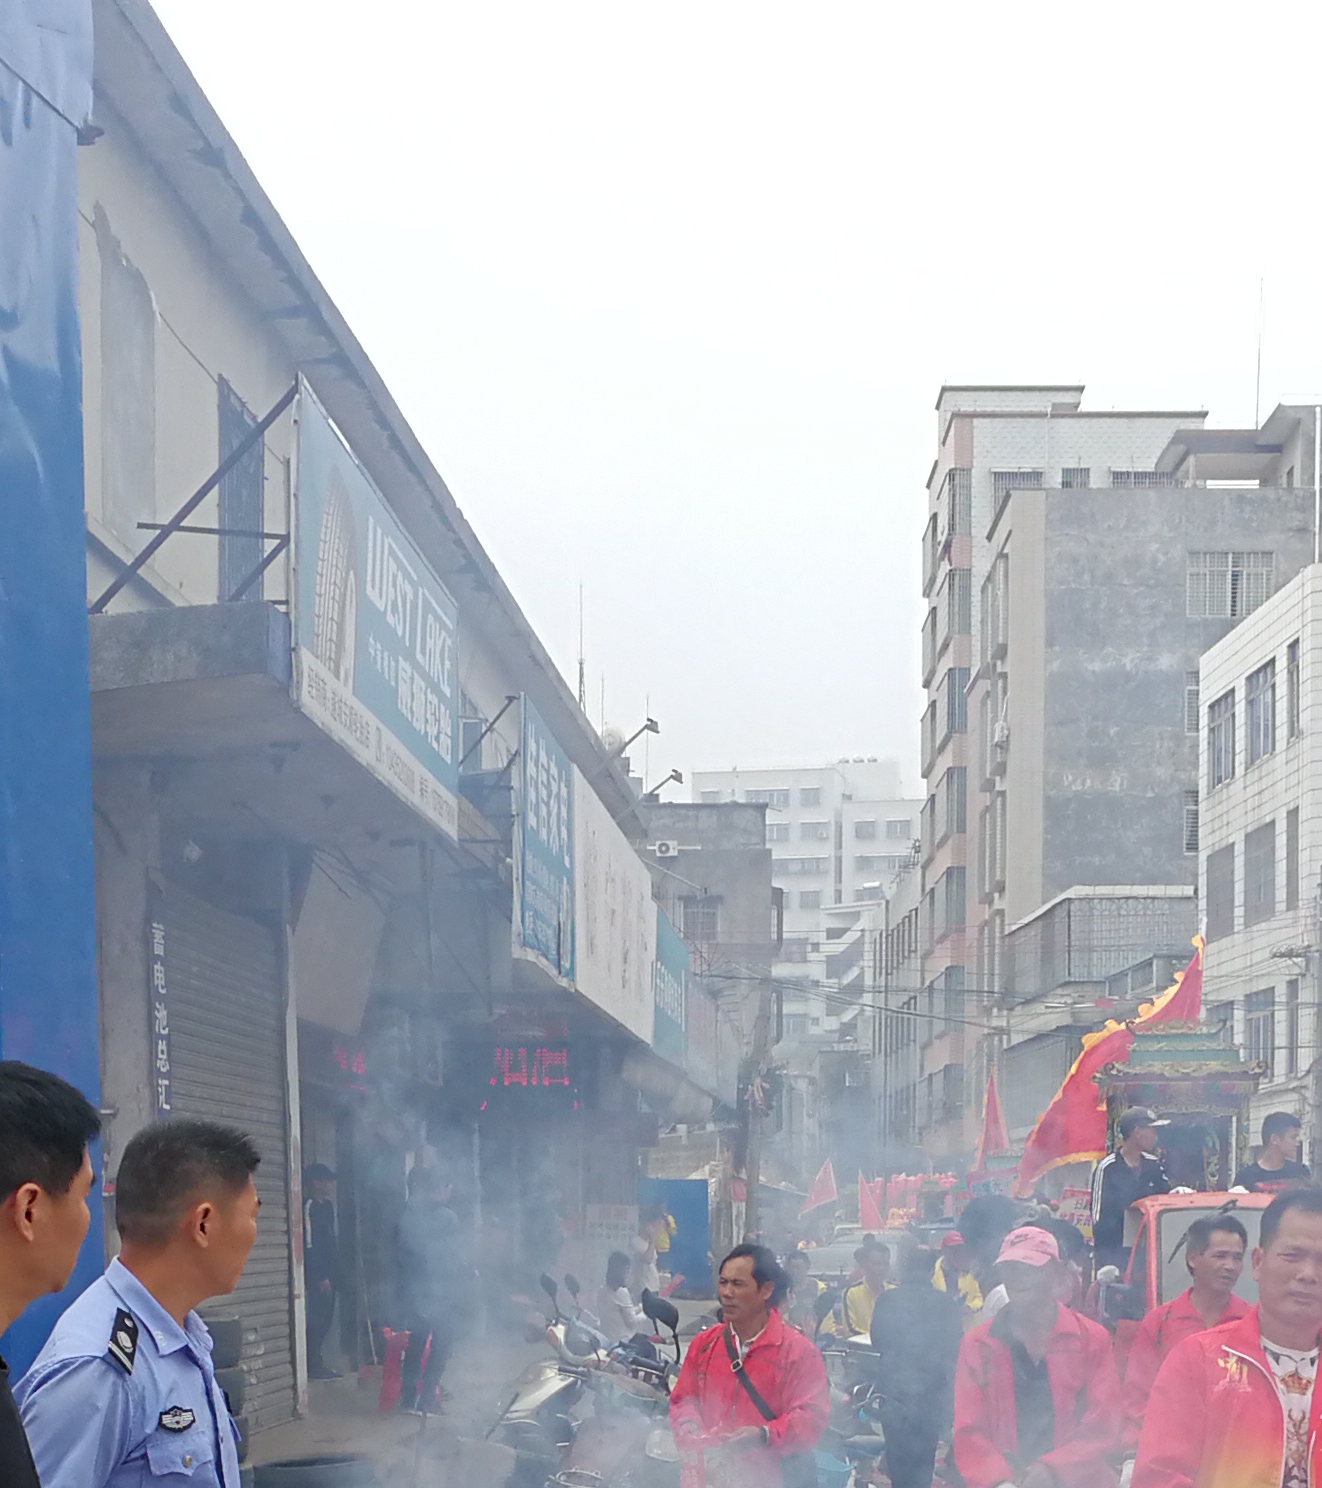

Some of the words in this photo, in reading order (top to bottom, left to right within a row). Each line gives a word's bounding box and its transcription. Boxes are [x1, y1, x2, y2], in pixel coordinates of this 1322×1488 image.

[366, 515, 417, 647] WEST
[416, 586, 454, 699] LAKE
[152, 922, 172, 1111] 蓄电池总汇
